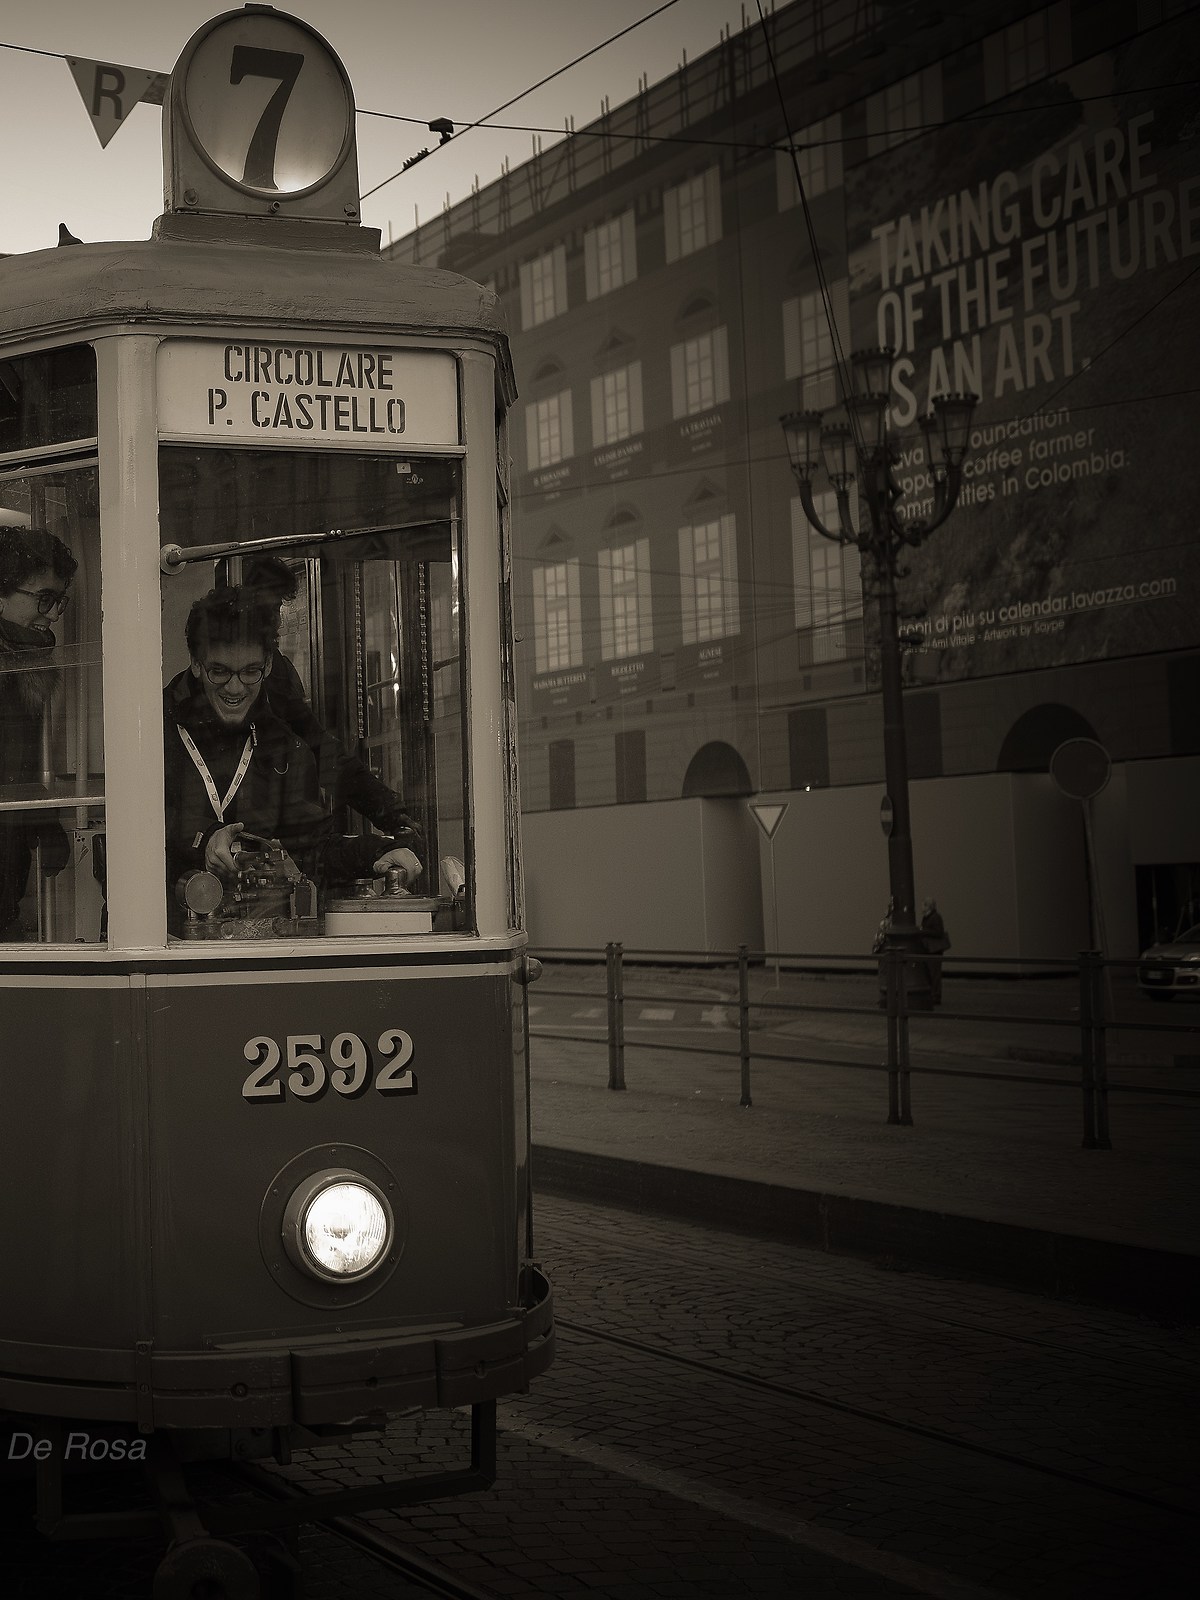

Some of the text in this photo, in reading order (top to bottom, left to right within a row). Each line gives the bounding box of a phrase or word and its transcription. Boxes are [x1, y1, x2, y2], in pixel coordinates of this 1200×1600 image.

[92, 64, 126, 121] R
[230, 44, 305, 190] 7
[871, 109, 1158, 290] TAKING CARE
[877, 174, 1200, 358] OF THE FUTURE
[224, 345, 393, 390] CIRCOLARE
[884, 357, 918, 432] S
[927, 333, 984, 415] AN
[208, 388, 406, 434] P. CASTELLO
[970, 406, 1071, 449] oundation
[962, 447, 1023, 479] coffee
[1029, 427, 1096, 461] farmer
[1001, 474, 1020, 497] in
[1025, 448, 1131, 490] Colombia.
[978, 607, 995, 626] su
[999, 576, 1177, 623] calendar.lavazza.com
[984, 625, 1017, 642] Artwork
[241, 1028, 416, 1102] 2592
